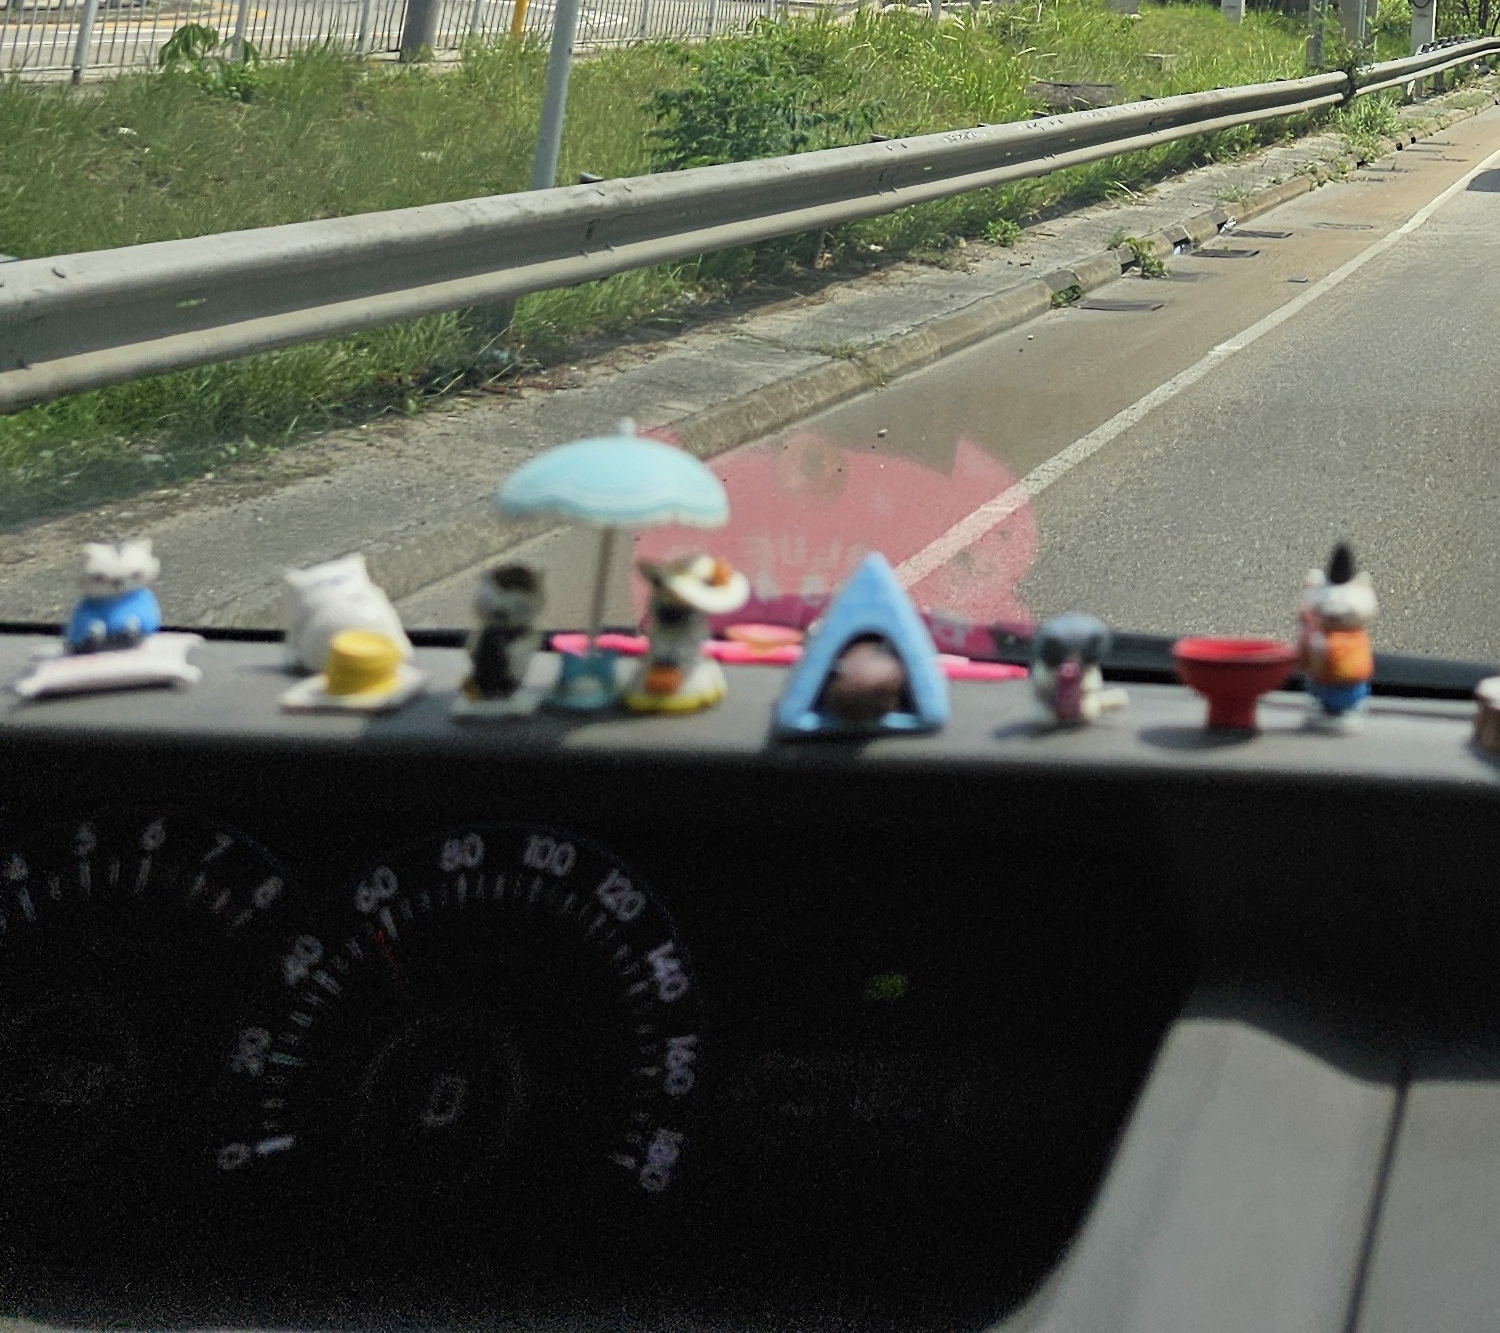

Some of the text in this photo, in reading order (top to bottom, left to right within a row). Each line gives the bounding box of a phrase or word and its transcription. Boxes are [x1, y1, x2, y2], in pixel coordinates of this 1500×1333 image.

[439, 831, 486, 873] 80
[522, 834, 578, 877] 100
[597, 866, 647, 923] 120
